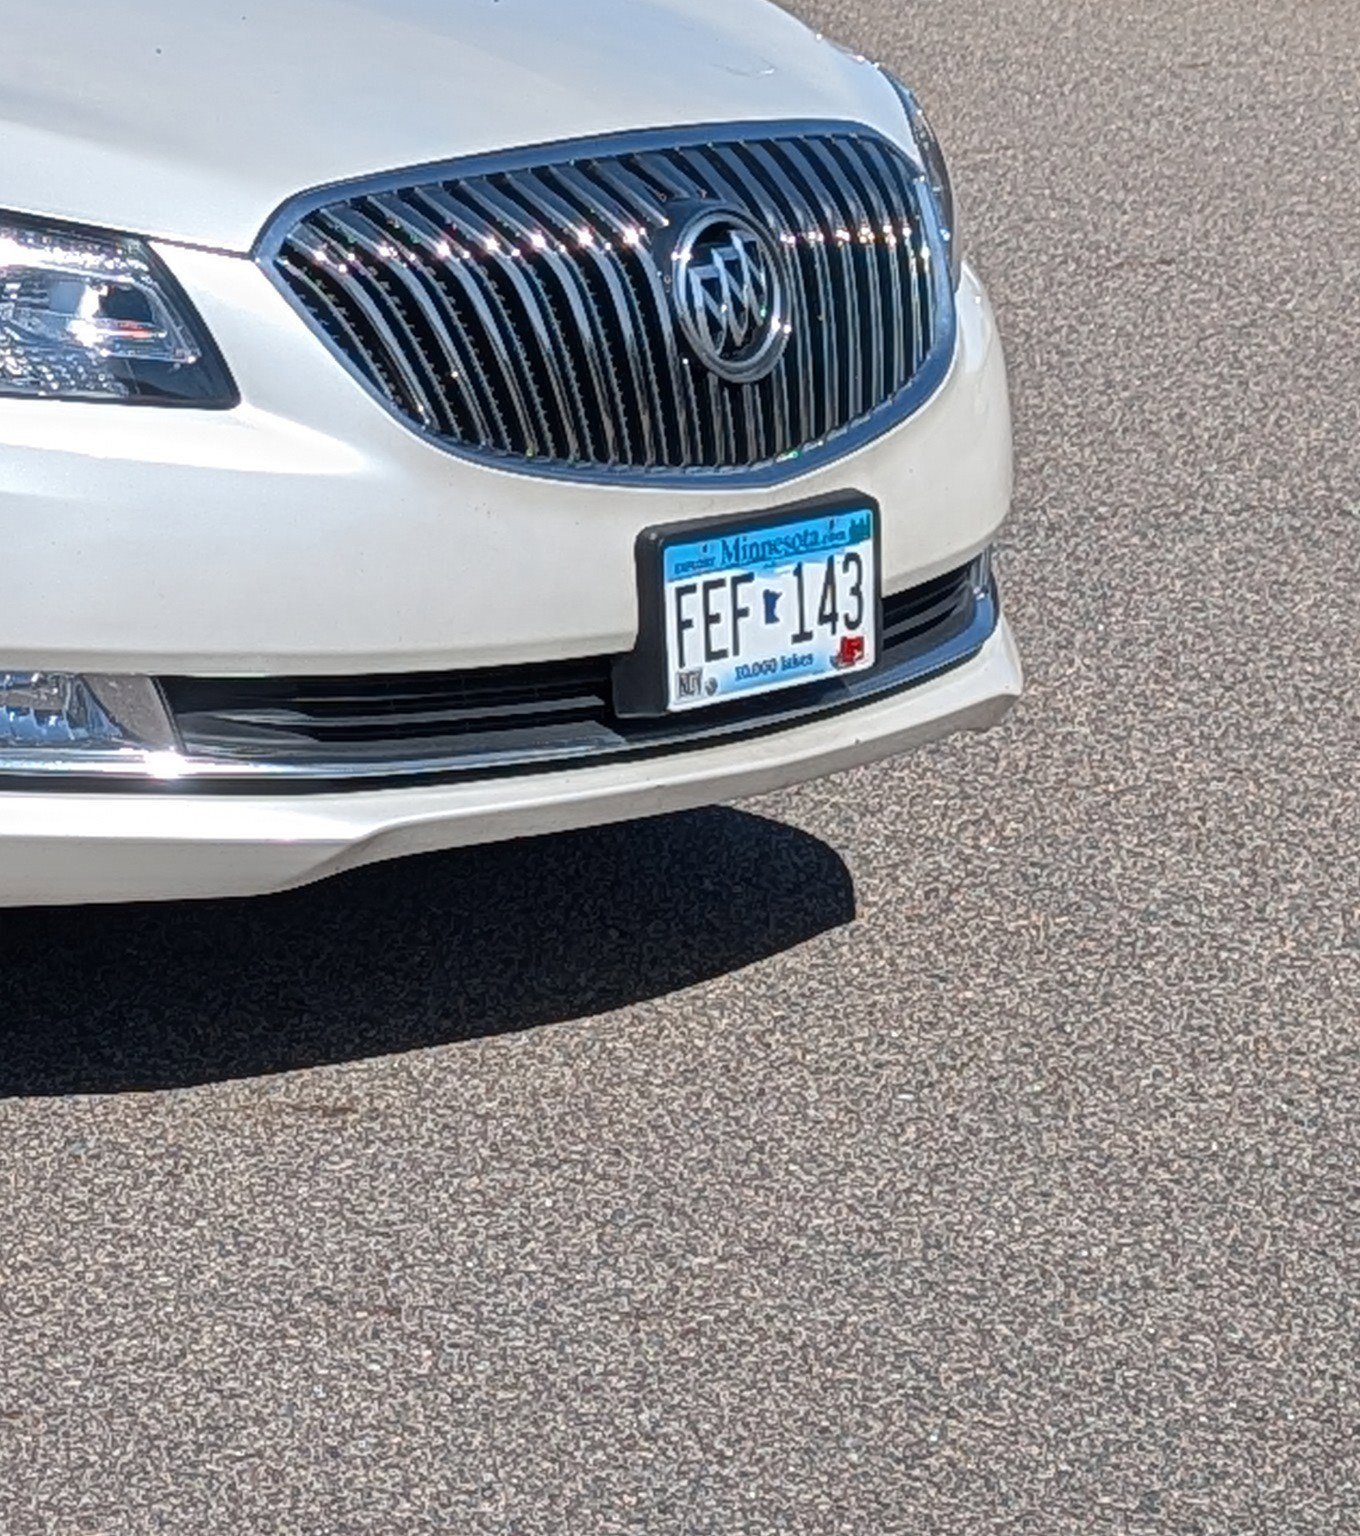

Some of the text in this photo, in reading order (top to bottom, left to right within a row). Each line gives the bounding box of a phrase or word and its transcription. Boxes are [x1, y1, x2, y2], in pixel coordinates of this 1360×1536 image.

[721, 531, 819, 566] Minnesota
[675, 552, 865, 669] FEF 143
